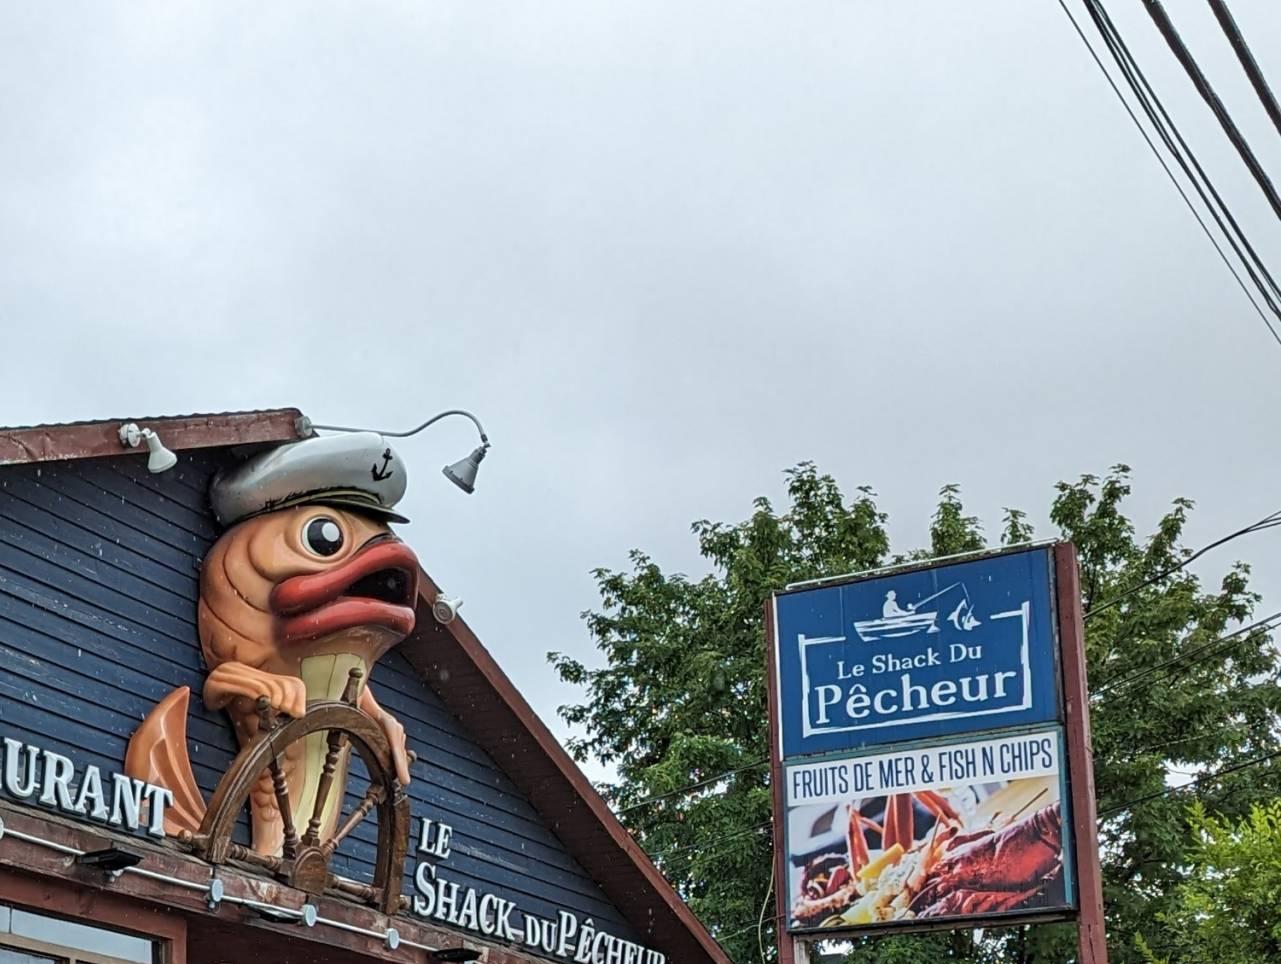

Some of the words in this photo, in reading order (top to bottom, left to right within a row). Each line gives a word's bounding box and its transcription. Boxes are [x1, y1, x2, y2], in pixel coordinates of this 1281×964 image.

[837, 661, 865, 680] Le
[872, 648, 942, 674] Shack
[949, 643, 982, 663] Du
[814, 669, 1017, 725] Pêcheur
[793, 765, 848, 799] FRUITS
[854, 762, 874, 792] DE
[879, 756, 915, 788] MER
[921, 754, 934, 784] &
[939, 748, 977, 781] FISH
[982, 746, 994, 776] N
[999, 738, 1052, 774] CHIPS
[419, 817, 453, 859] LE
[413, 862, 517, 941] SHACK
[523, 914, 558, 952] DU
